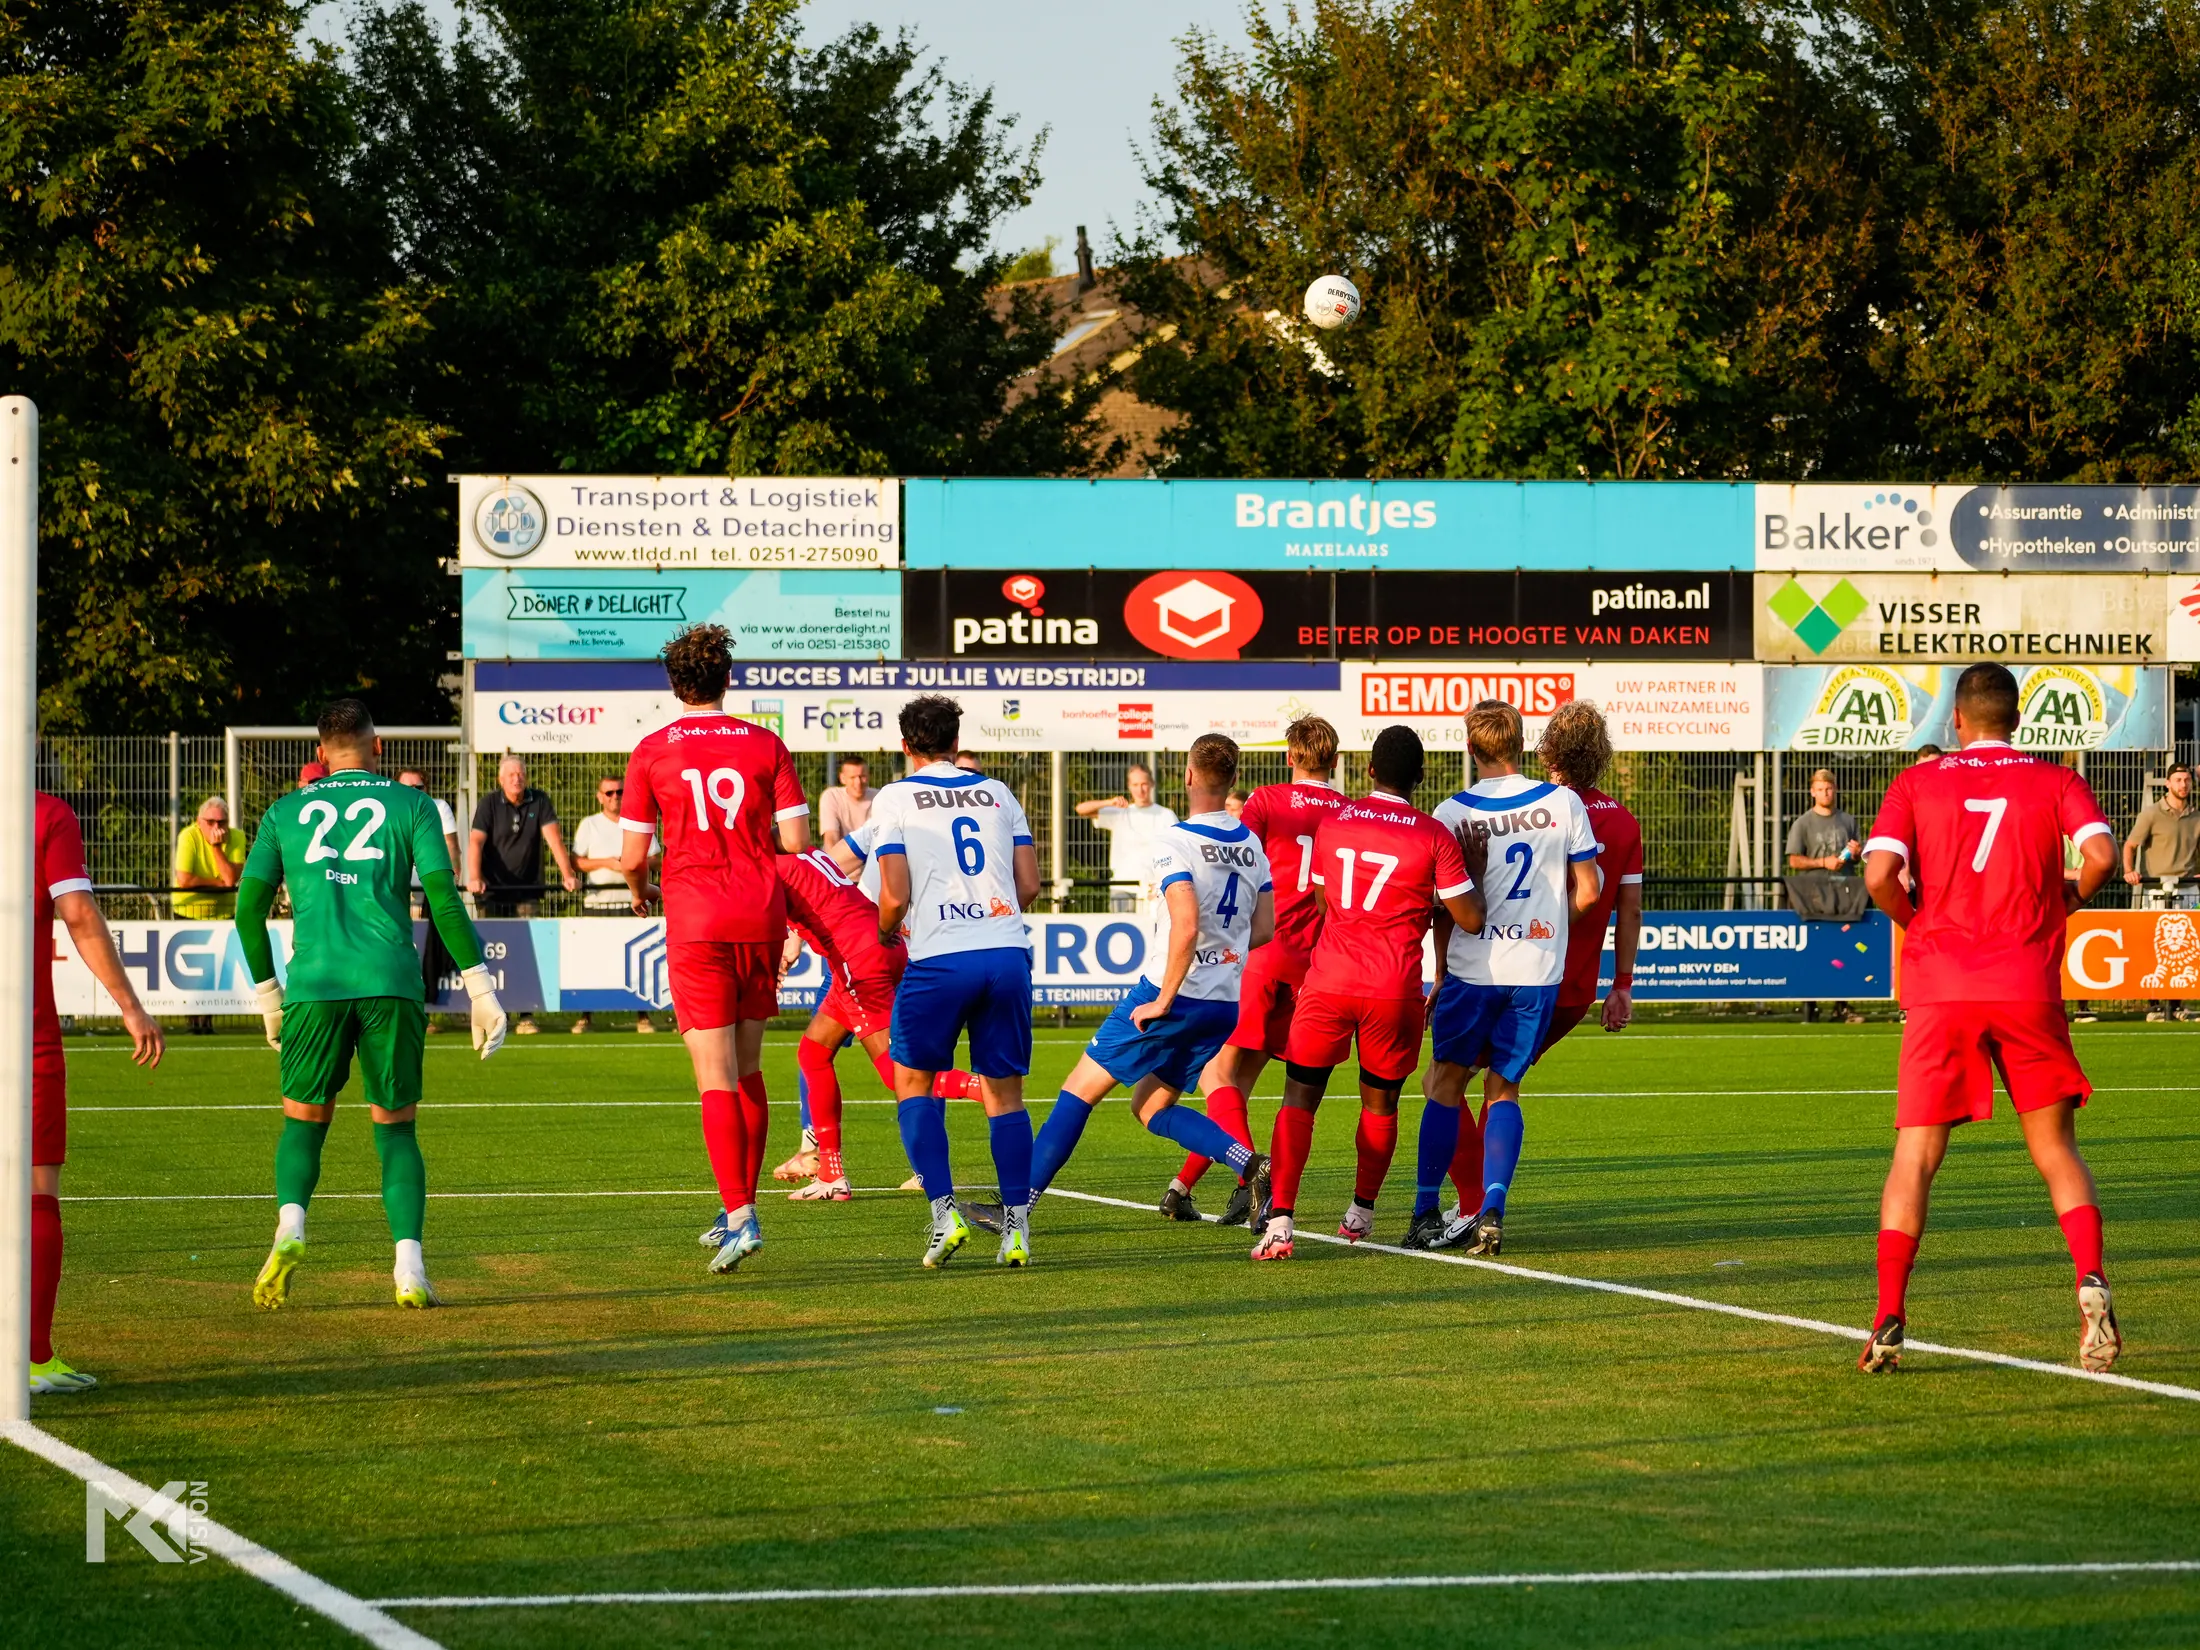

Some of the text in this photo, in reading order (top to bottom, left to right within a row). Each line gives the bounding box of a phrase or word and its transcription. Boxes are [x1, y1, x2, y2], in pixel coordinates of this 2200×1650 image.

[571, 487, 879, 512] Transport & Logistiek
[487, 512, 533, 531] TLDD
[1236, 493, 1437, 536] Brantjes
[1989, 504, 2083, 520] Assurantie
[557, 517, 894, 543] Diensten & Detachering
[1765, 513, 1910, 550] Bakker
[575, 547, 878, 561] www.tldd.nl tel. 0251-275090
[1285, 543, 1389, 557] MAKELAARS
[1989, 537, 2096, 557] Hypotheken
[523, 594, 674, 614] DÖNER DELIGHT
[1592, 583, 1710, 615] patina.nl
[835, 607, 890, 618] Bestel nu
[1879, 603, 1981, 624] VISSER
[740, 624, 890, 637] via www.donerdelight.nl
[953, 611, 1098, 653] patina
[1298, 627, 1710, 644] BETER OP DE HOOGTE VAN DAKEN
[771, 640, 890, 650] of via 0251-215380
[1880, 633, 2153, 654] ELEKTROTECHNIEK
[745, 667, 841, 686] SUCCES
[848, 667, 899, 686] MET
[905, 667, 987, 686] JULLIE
[995, 667, 1146, 686] WEDSTRIJD!
[1616, 681, 1736, 693] UW PARTNER IN
[499, 701, 604, 725] Castor
[1604, 701, 1750, 714] AFVALINZAMELING
[1836, 689, 1888, 725] AA
[2032, 689, 2083, 725] AA
[803, 706, 883, 729] Forta
[531, 731, 573, 743] college
[682, 726, 749, 735] vdv-vh.nl
[1623, 722, 1731, 734] EN RECYCLING
[1823, 727, 1894, 745] DRINK
[2020, 727, 2089, 745] DRINK
[319, 780, 391, 788] vdv-vh.nl
[681, 767, 745, 831] 19
[1353, 808, 1416, 826] vdv-vh.nl
[298, 798, 386, 863] 22
[1964, 797, 2008, 873] 7
[952, 816, 985, 876] 6
[326, 869, 358, 884] DEEN
[1336, 847, 1399, 911] 17
[1505, 842, 1533, 900] 2
[1216, 872, 1241, 929] 4
[938, 903, 984, 921] ING
[1195, 951, 1219, 965] NG
[1657, 965, 1677, 974] van
[1679, 963, 1711, 974] RKVV
[1713, 963, 1739, 974] DEM
